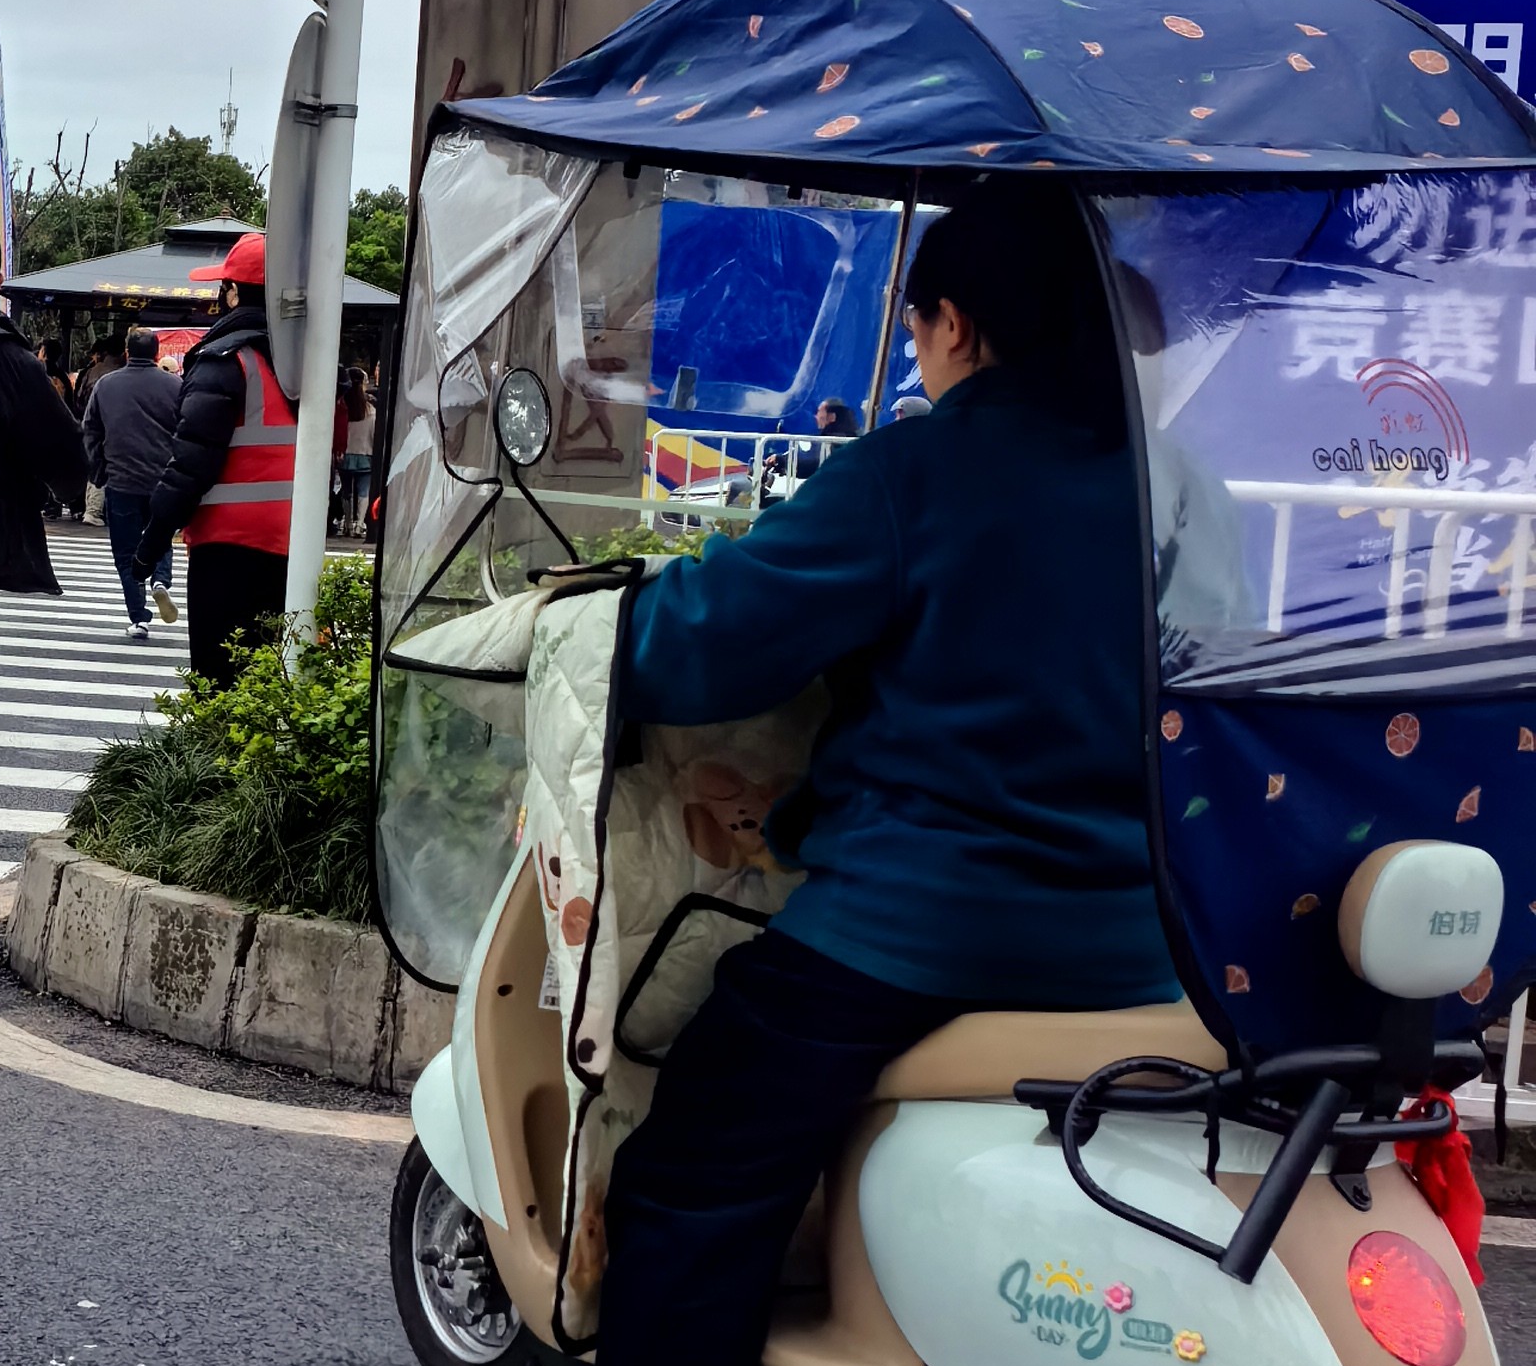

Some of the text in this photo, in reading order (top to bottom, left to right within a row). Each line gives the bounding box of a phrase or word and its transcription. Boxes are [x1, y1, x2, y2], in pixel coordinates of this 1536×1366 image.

[1313, 438, 1450, 481] cai hong
[998, 1259, 1111, 1361] Sunny
